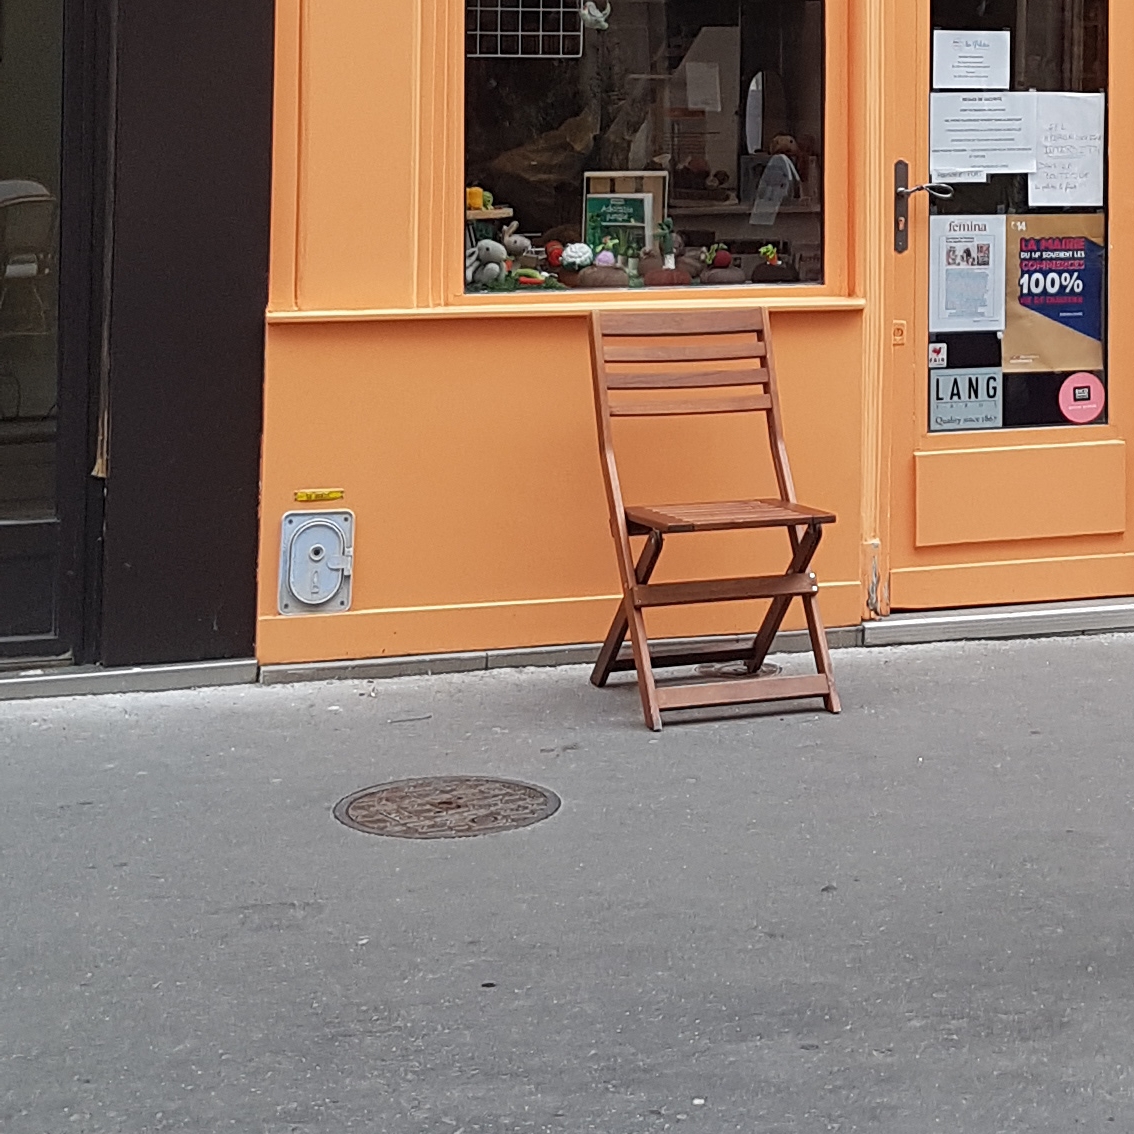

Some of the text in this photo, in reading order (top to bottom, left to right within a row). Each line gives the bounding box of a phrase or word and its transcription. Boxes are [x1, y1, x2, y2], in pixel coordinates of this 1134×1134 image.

[948, 220, 987, 232] femina
[1019, 272, 1083, 294] 100%
[935, 375, 998, 401] LANG
